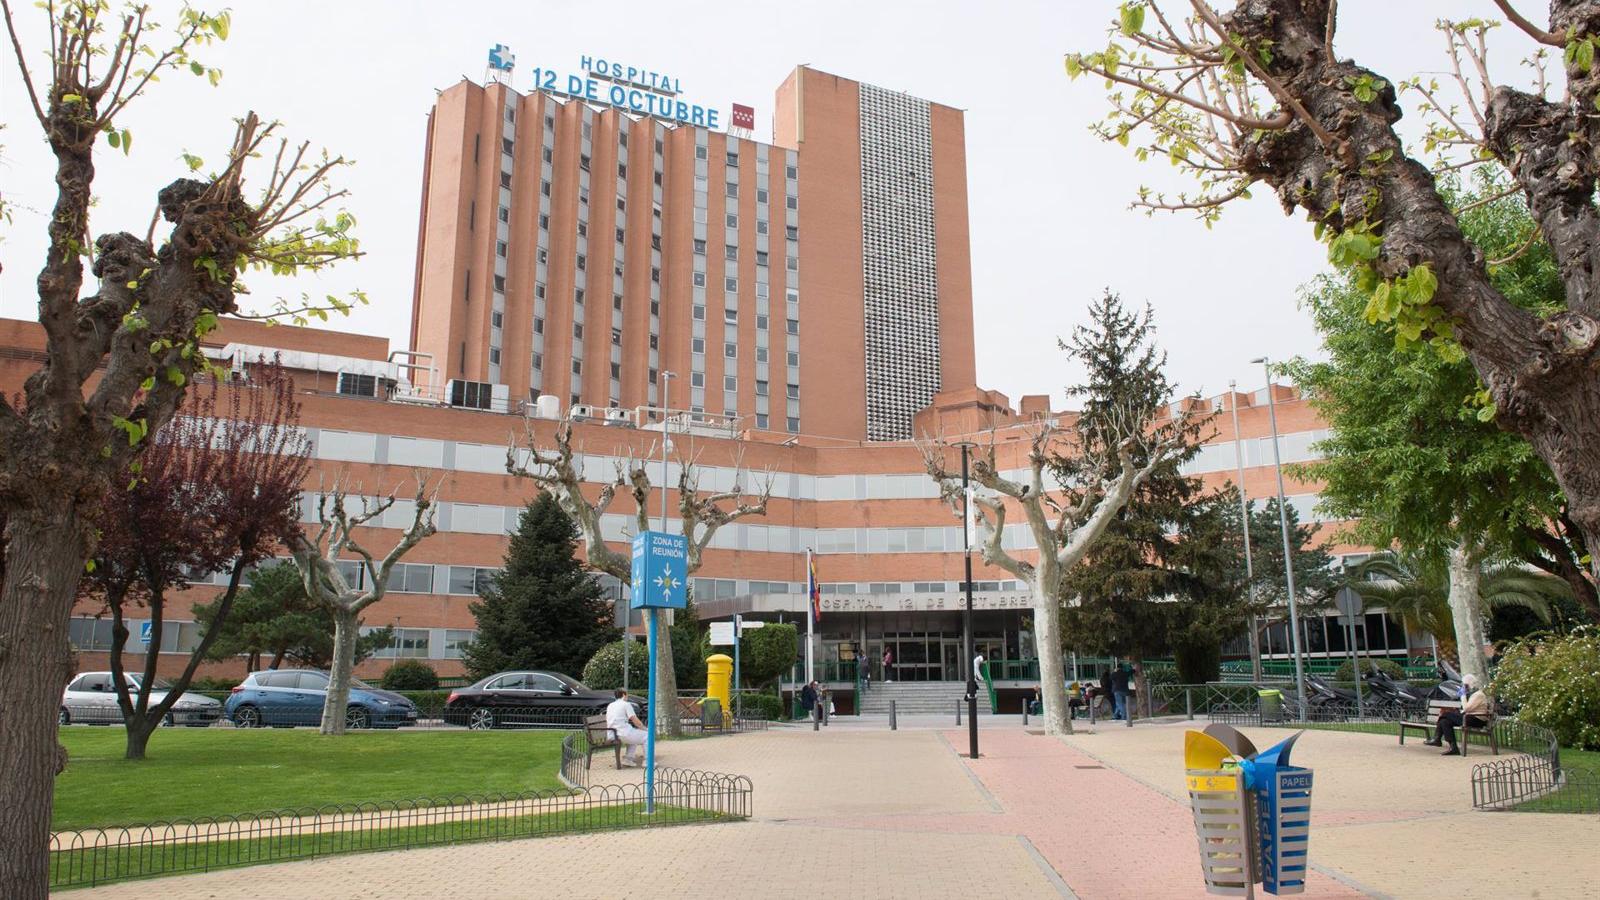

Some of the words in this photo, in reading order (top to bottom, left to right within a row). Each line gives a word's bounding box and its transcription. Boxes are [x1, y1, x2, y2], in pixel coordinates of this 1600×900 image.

[581, 54, 683, 94] HOSPITAL
[532, 67, 557, 89] 12
[568, 74, 598, 100] DE
[610, 85, 719, 128] OCTUBRE
[652, 536, 672, 546] ZONA
[674, 539, 684, 548] DE
[652, 546, 684, 559] REUNIÓN
[822, 599, 883, 609] OSPITAL
[1281, 777, 1310, 787] PAPEL
[1261, 781, 1275, 883] PAPEL
